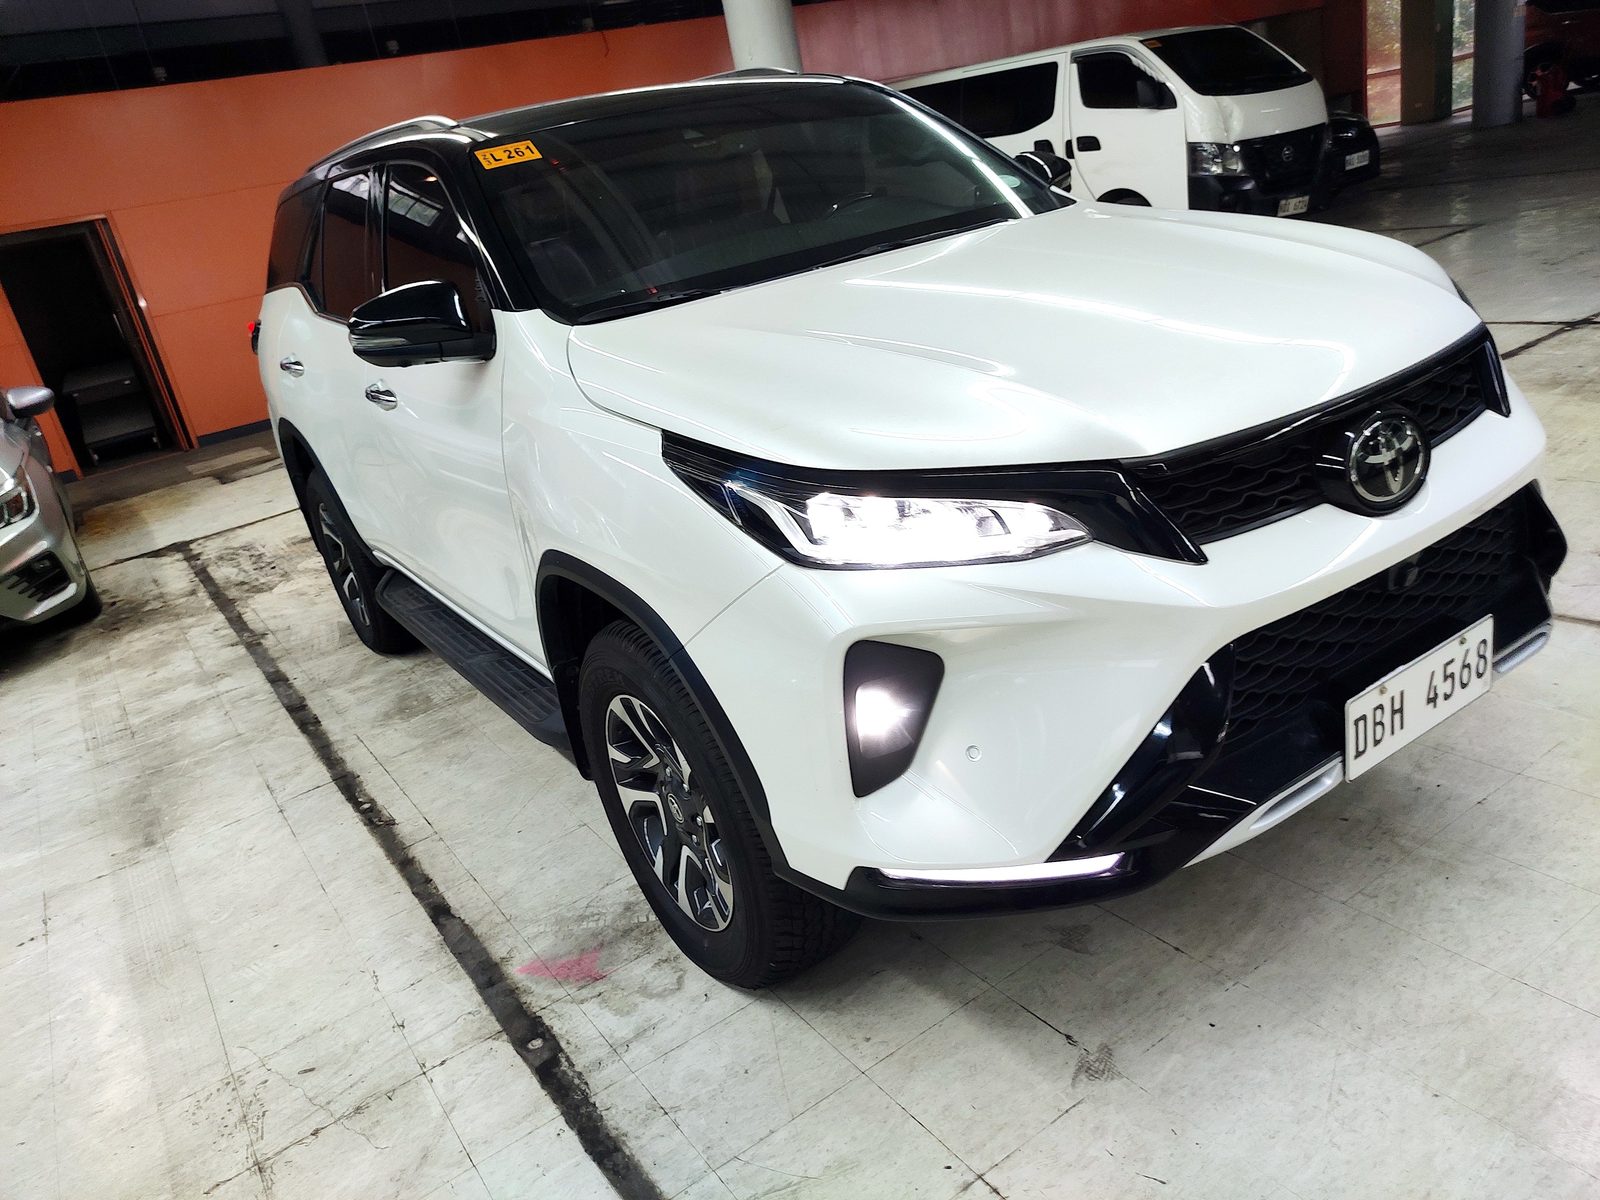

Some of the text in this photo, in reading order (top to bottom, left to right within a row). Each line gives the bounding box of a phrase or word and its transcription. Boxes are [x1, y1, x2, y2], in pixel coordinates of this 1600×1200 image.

[490, 153, 503, 162] L
[503, 145, 535, 159] 261
[1353, 638, 1488, 760] DBH 4568
